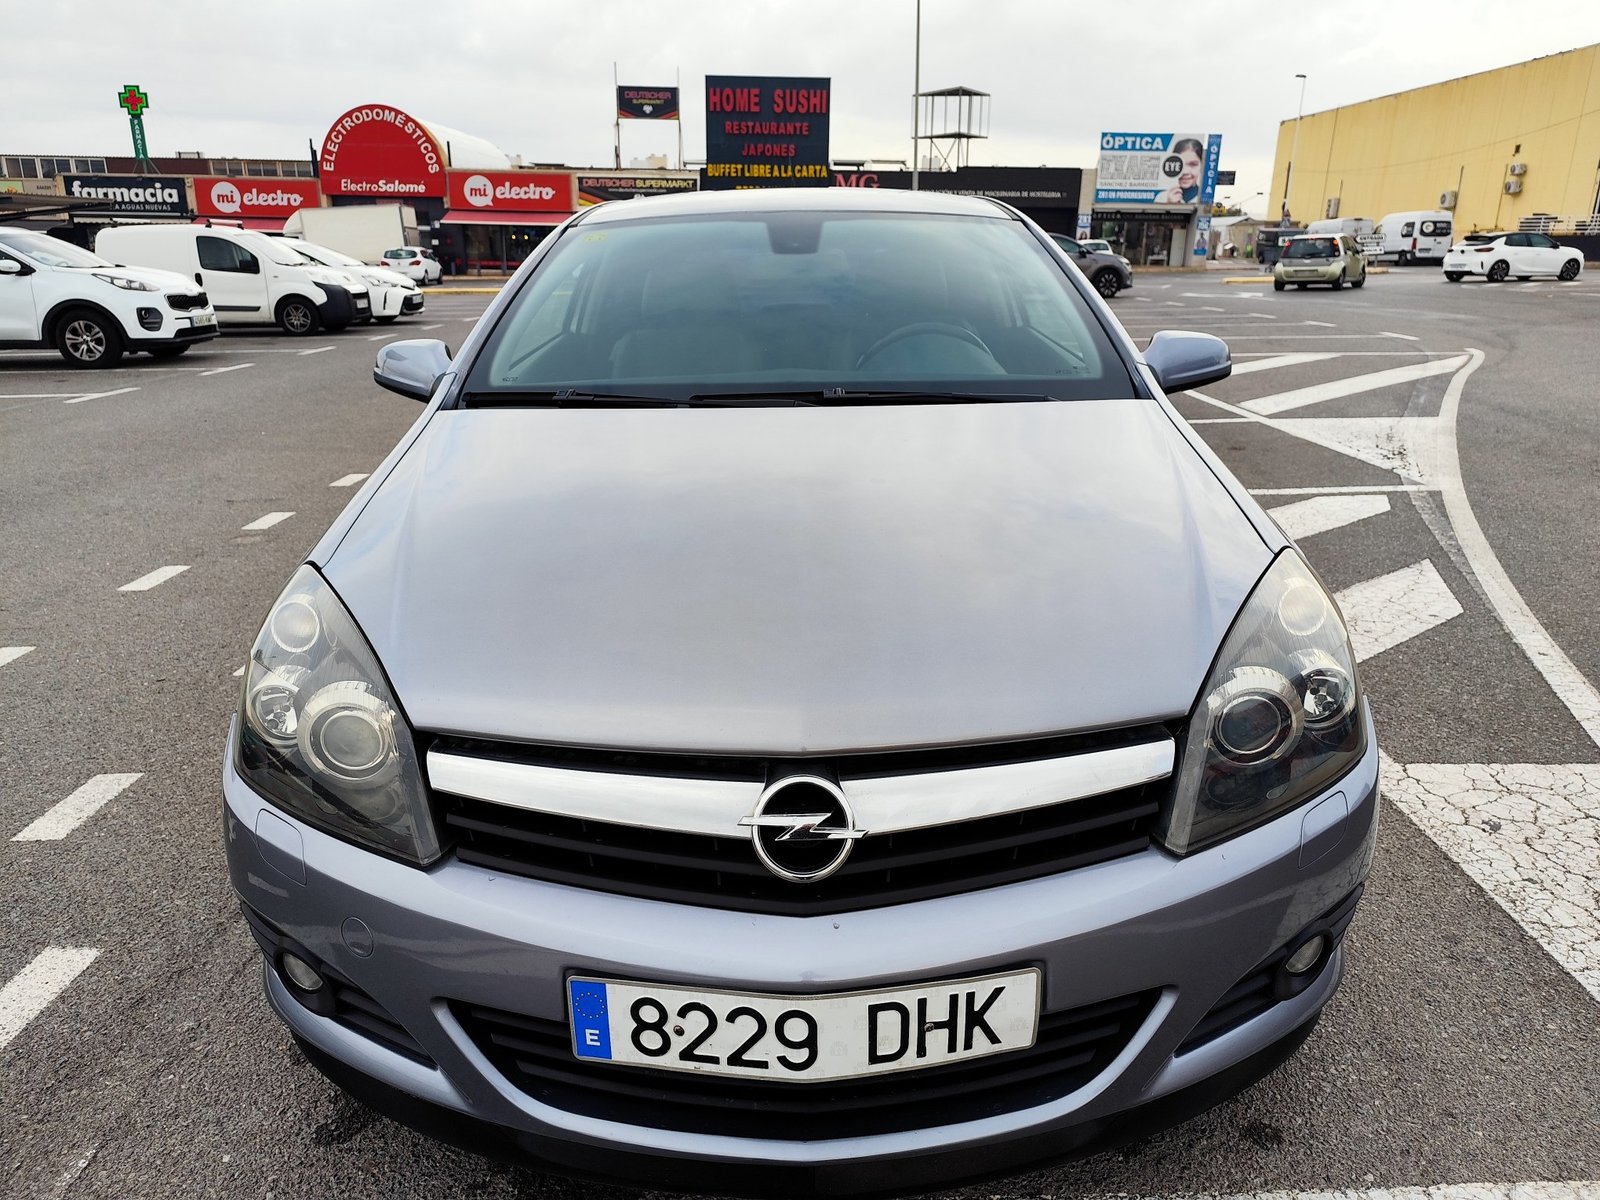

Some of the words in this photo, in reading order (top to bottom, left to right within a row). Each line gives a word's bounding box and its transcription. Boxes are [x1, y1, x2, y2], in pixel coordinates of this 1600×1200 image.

[624, 91, 672, 99] DEUTSCHER
[709, 88, 760, 112] HOME
[773, 88, 827, 114] SUSHI
[725, 121, 809, 135] RESTAURANTE
[133, 119, 145, 159] FARMACIA
[323, 108, 440, 174] ELECTRODOMÉSTICOS
[1102, 133, 1164, 150] ÓPTICA
[742, 143, 796, 157] JAPONES
[707, 164, 743, 176] BUFFET
[745, 164, 772, 177] LIBRE
[772, 164, 780, 177] A
[781, 165, 792, 177] LA
[794, 165, 828, 178] CARTA
[1164, 161, 1181, 172] EYE
[71, 180, 179, 203] farmacia
[341, 178, 426, 193] ElectroSalomé
[470, 185, 488, 197] mi
[495, 183, 556, 200] electro
[583, 178, 634, 188] DEUTSCHER
[635, 179, 694, 188] SUPERMARKT
[217, 190, 236, 204] mi
[243, 187, 303, 207] electro
[585, 1029, 600, 1046] E
[629, 997, 819, 1072] 8229
[867, 986, 1006, 1066] DHK
